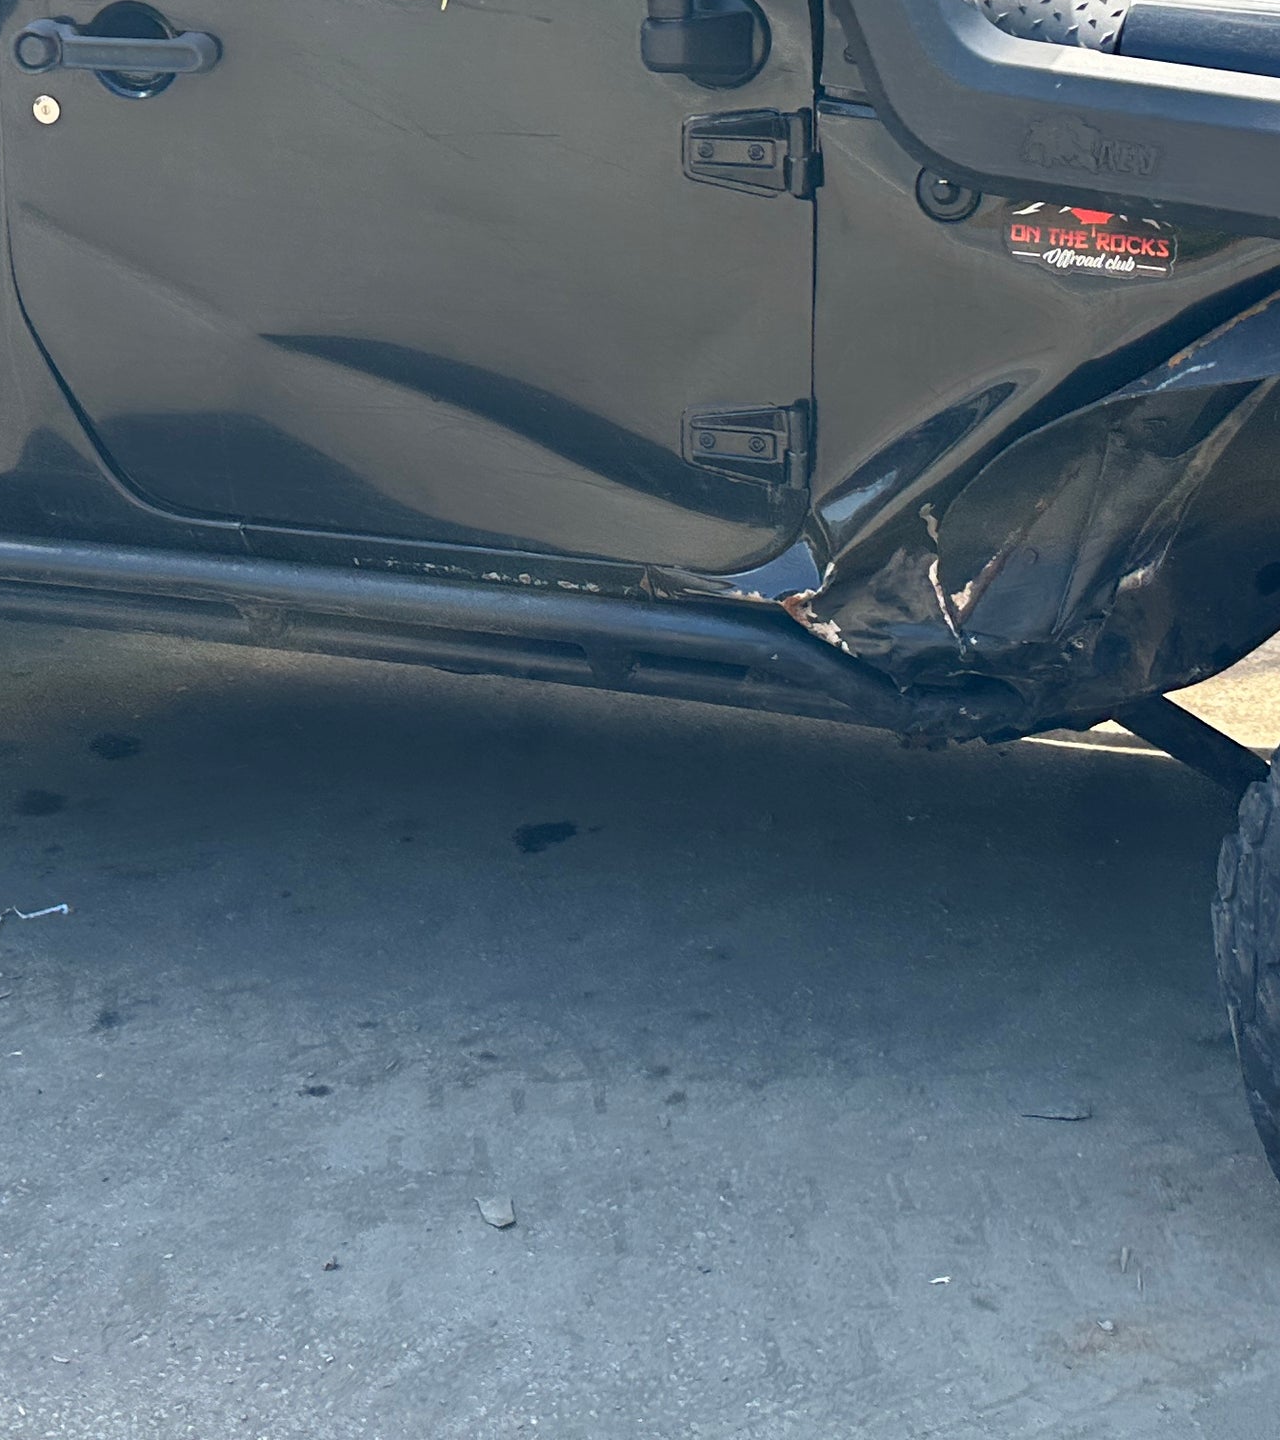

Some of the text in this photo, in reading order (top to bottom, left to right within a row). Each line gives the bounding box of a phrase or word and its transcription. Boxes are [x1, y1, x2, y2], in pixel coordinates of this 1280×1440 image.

[1010, 223, 1171, 258] ON THE ROCKS
[1041, 247, 1136, 272] Offroad club
